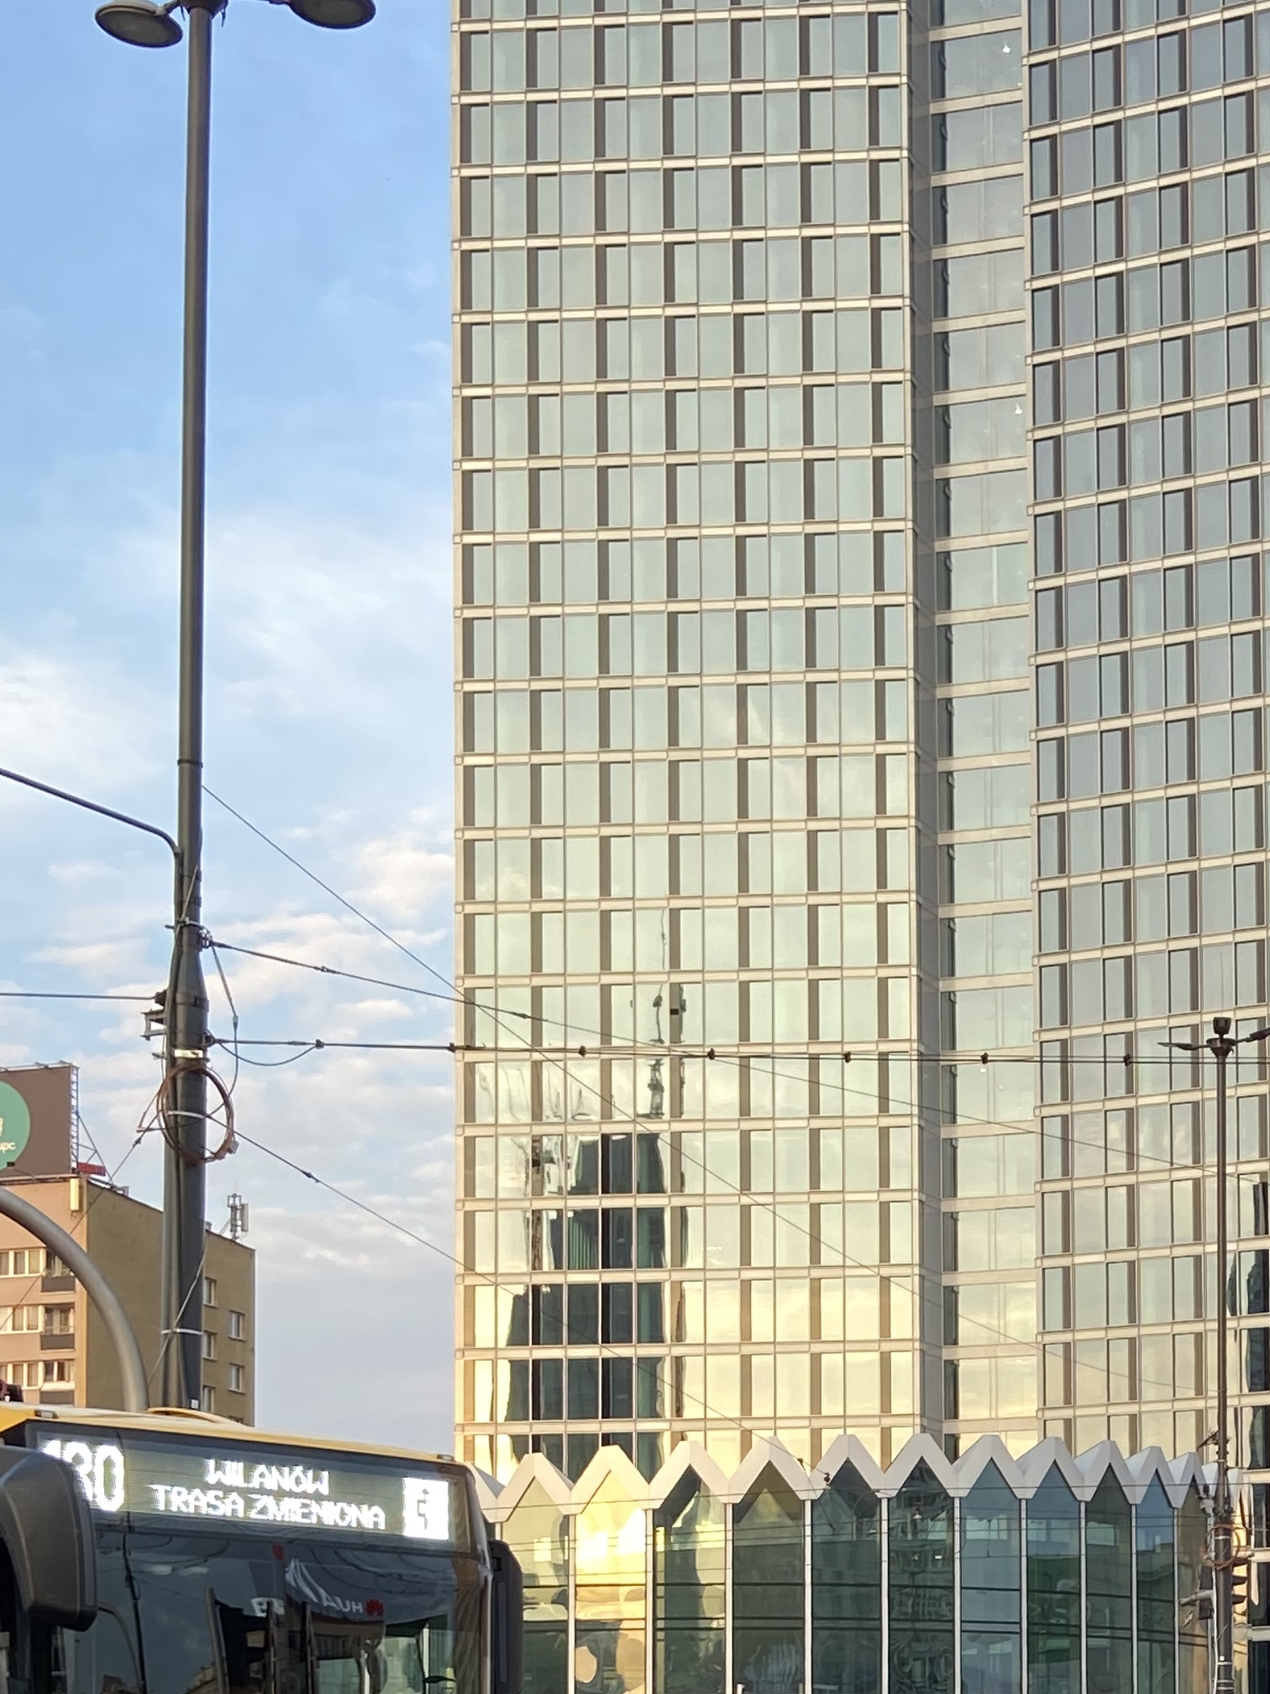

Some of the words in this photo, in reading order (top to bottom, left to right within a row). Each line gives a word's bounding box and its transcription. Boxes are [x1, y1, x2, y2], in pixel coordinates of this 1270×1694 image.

[204, 1458, 329, 1495] WILANÓW
[148, 1484, 244, 1518] TRASA
[248, 1494, 386, 1530] ZMIENIONA
